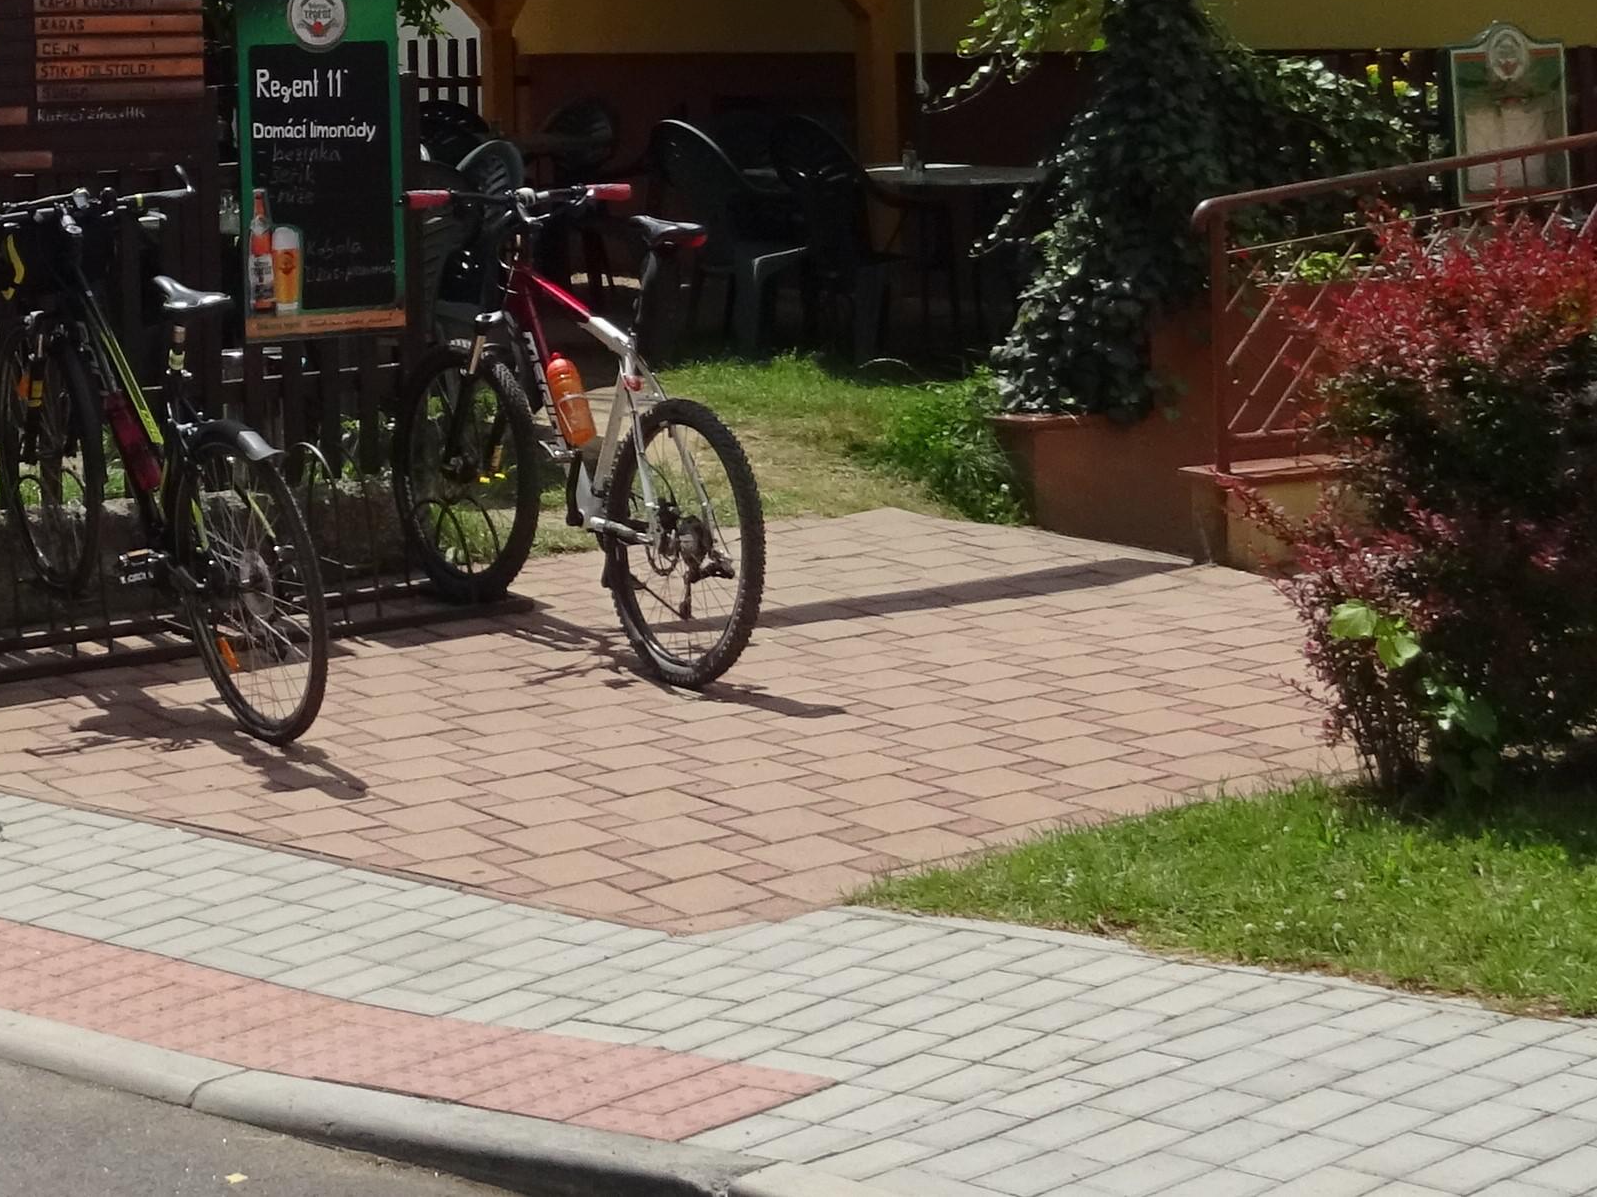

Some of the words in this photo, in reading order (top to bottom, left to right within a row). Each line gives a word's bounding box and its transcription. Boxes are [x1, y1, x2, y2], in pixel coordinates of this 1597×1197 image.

[40, 18, 85, 33] KARAS
[41, 42, 80, 56] CEJN
[256, 68, 319, 103] Regent
[252, 117, 307, 139] Domácí
[309, 116, 376, 142] limonády
